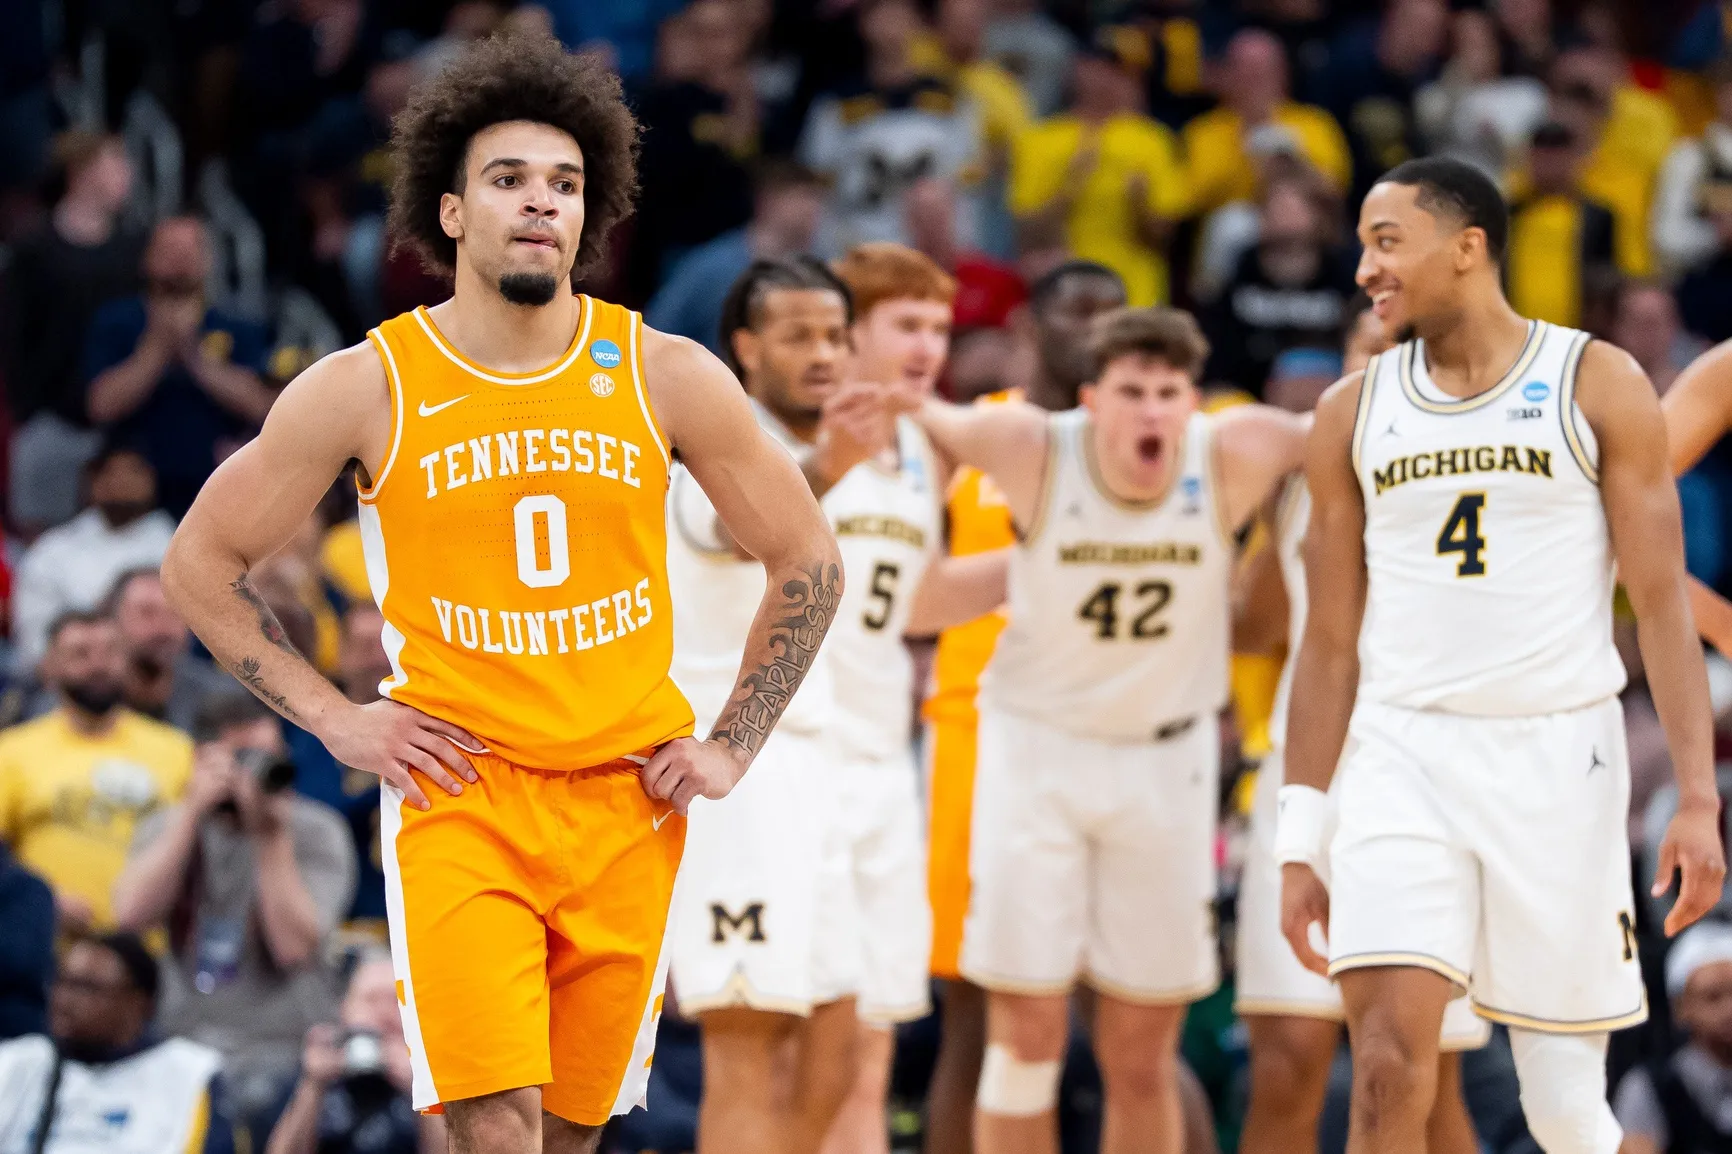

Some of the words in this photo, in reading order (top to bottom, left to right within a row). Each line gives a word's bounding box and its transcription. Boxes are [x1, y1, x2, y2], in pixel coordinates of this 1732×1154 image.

[591, 375, 613, 395] SEC
[595, 351, 620, 362] NCAA
[419, 428, 641, 499] TENNESSEE
[1373, 446, 1553, 496] MICHIGAN
[513, 494, 571, 588] 0
[1436, 491, 1486, 578] 4
[430, 577, 653, 655] VOLUNTEERS
[861, 560, 900, 633] 5
[1077, 577, 1175, 642] 42
[729, 584, 833, 756] FEARLESS
[711, 902, 766, 944] M
